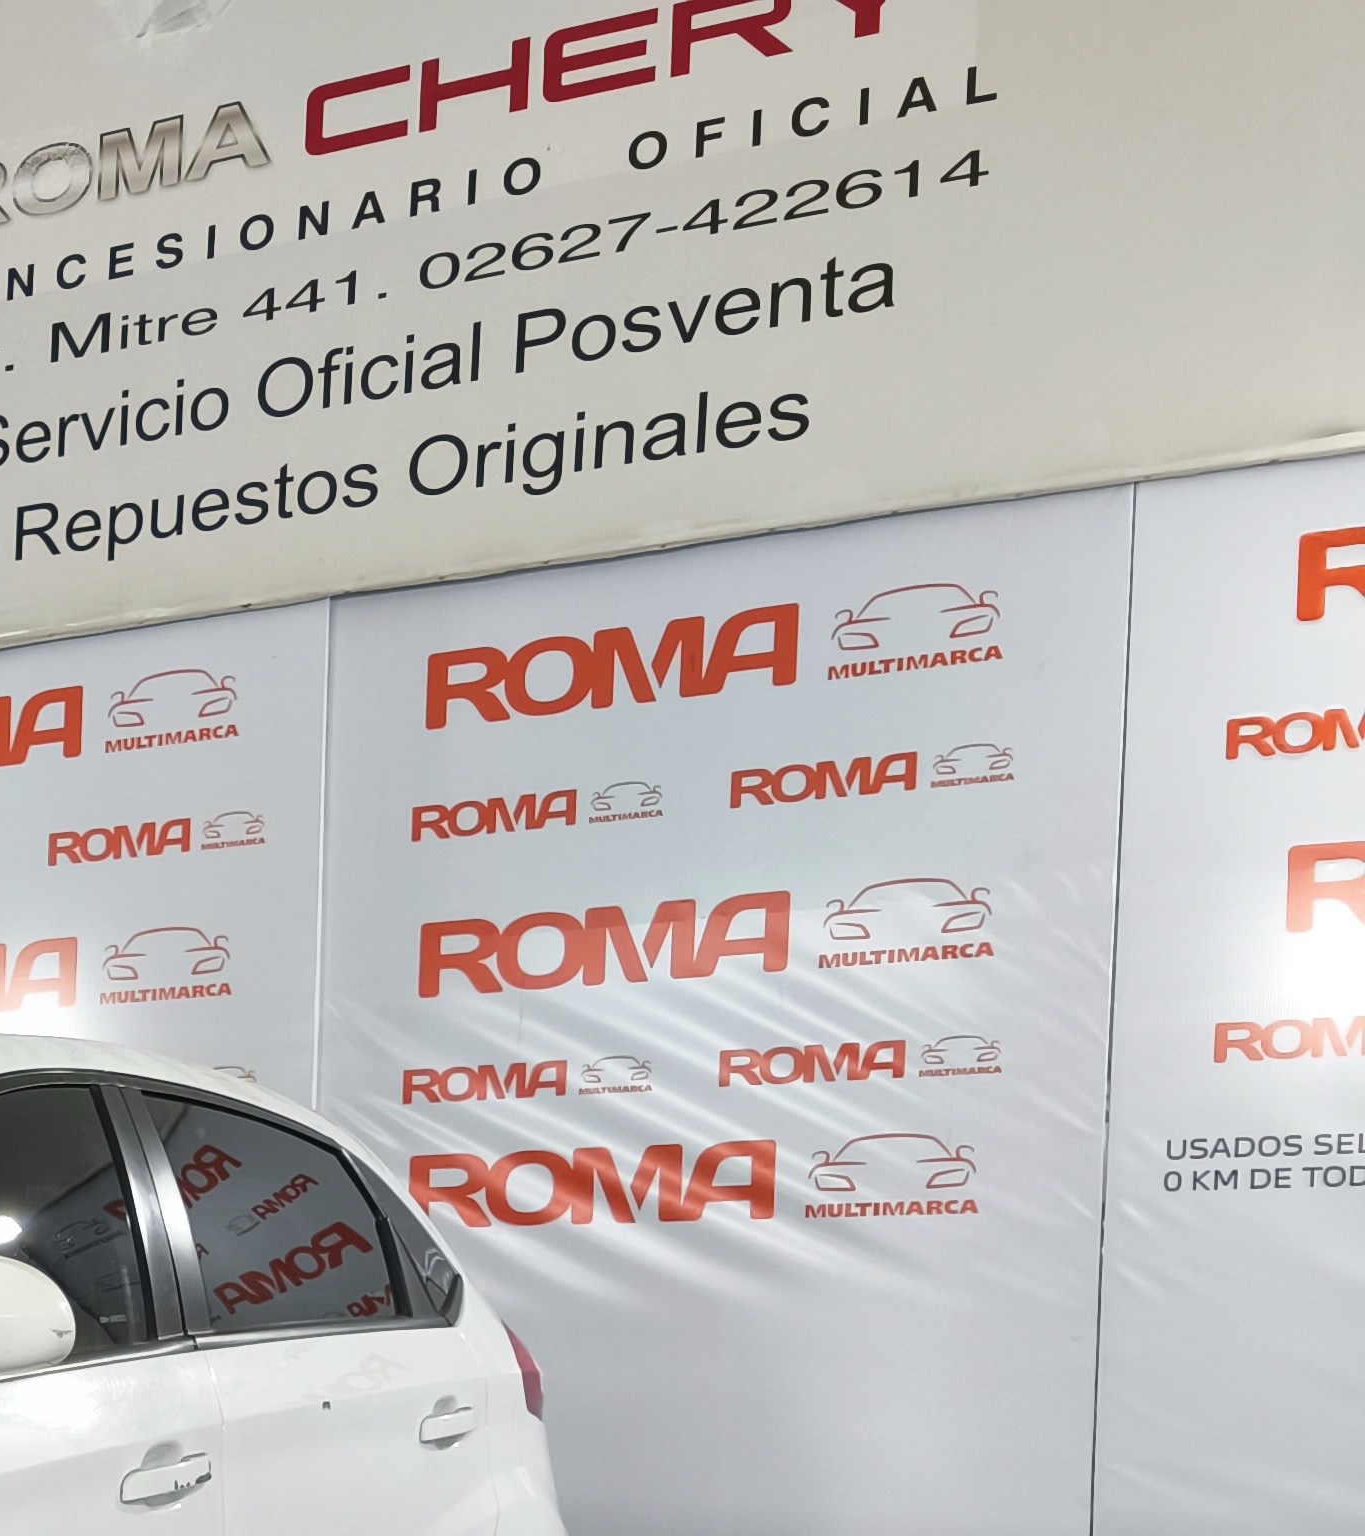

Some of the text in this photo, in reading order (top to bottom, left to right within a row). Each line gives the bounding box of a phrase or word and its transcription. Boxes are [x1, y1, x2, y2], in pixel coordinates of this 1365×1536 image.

[628, 66, 997, 170] OFICIAL
[50, 312, 218, 363] Mitre
[243, 270, 387, 321] 441.
[419, 150, 990, 290] 02627-422614
[257, 321, 481, 418] Oficial
[515, 257, 895, 374] Posventa
[14, 391, 810, 562] Repuestos Originales
[427, 604, 799, 730] ROMA
[827, 645, 1003, 681] MULTIMARCA
[104, 724, 239, 754] MULTIMARCA
[731, 753, 917, 808] ROMA
[413, 790, 577, 842] ROMA
[588, 807, 664, 824] MULTIMARCA
[49, 819, 191, 866] ROMA
[419, 892, 791, 998] ROMA
[817, 943, 995, 969] MULTIMARCA
[100, 982, 233, 1005] MULTIMARCA
[403, 1062, 567, 1104] ROMA
[720, 1041, 906, 1087] ROMA
[1166, 1134, 1303, 1161] USADOS
[409, 1141, 777, 1228] ROMA
[1192, 1169, 1238, 1191] KM
[1250, 1167, 1292, 1189] DE
[805, 1200, 979, 1219] MULTIMARCA
